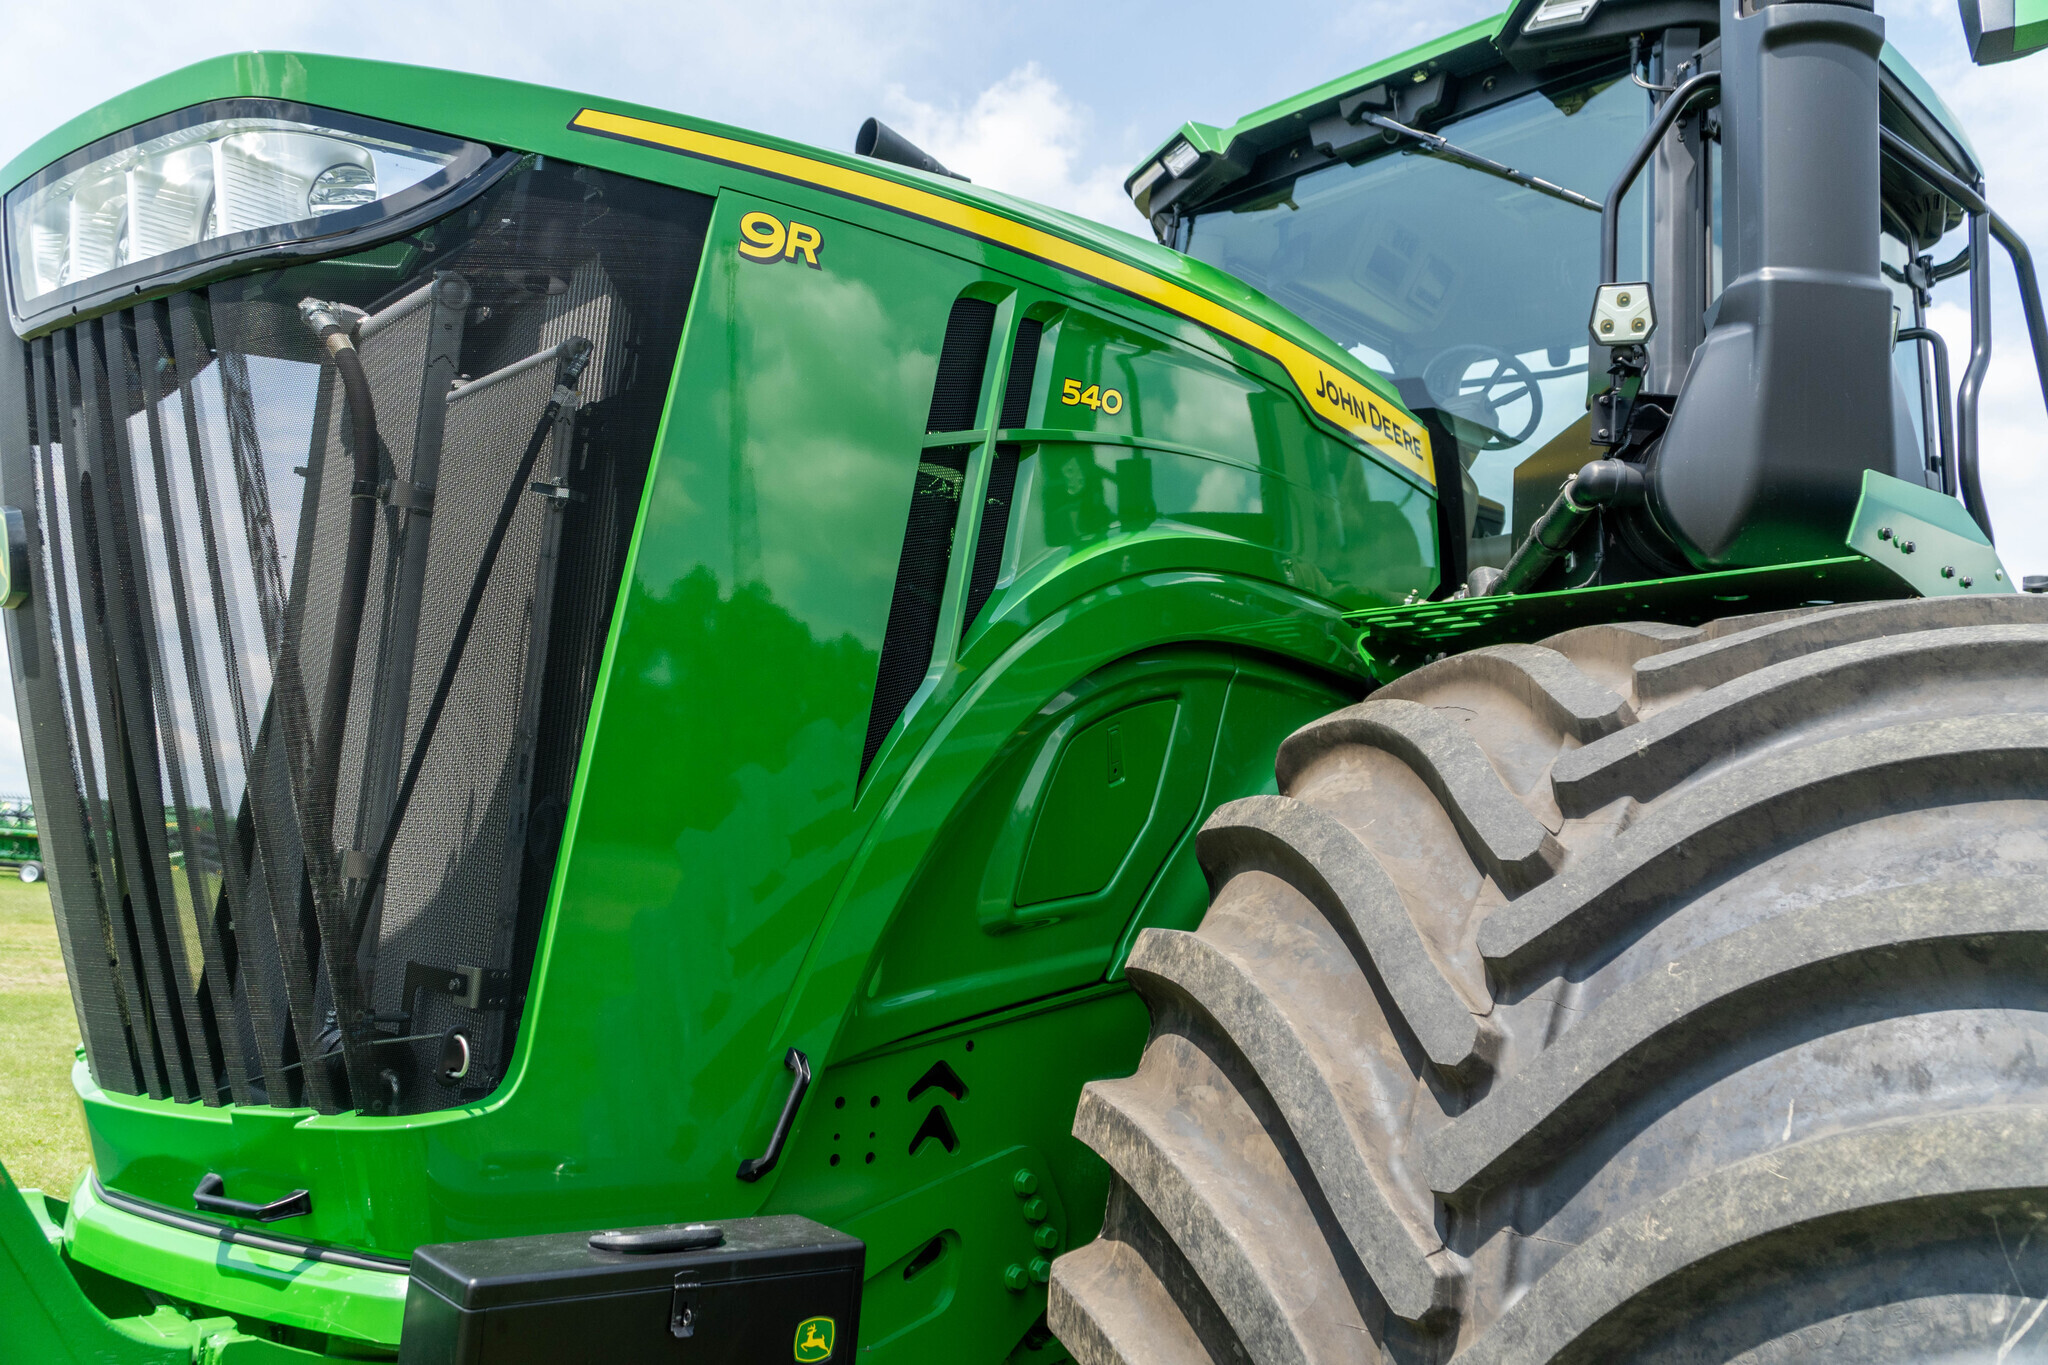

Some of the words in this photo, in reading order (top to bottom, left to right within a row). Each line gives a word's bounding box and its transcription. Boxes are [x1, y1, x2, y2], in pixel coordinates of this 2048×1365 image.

[738, 211, 824, 271] 9R
[1061, 377, 1123, 416] 540
[1316, 370, 1367, 424] JOHN
[1368, 401, 1424, 461] DEERE
